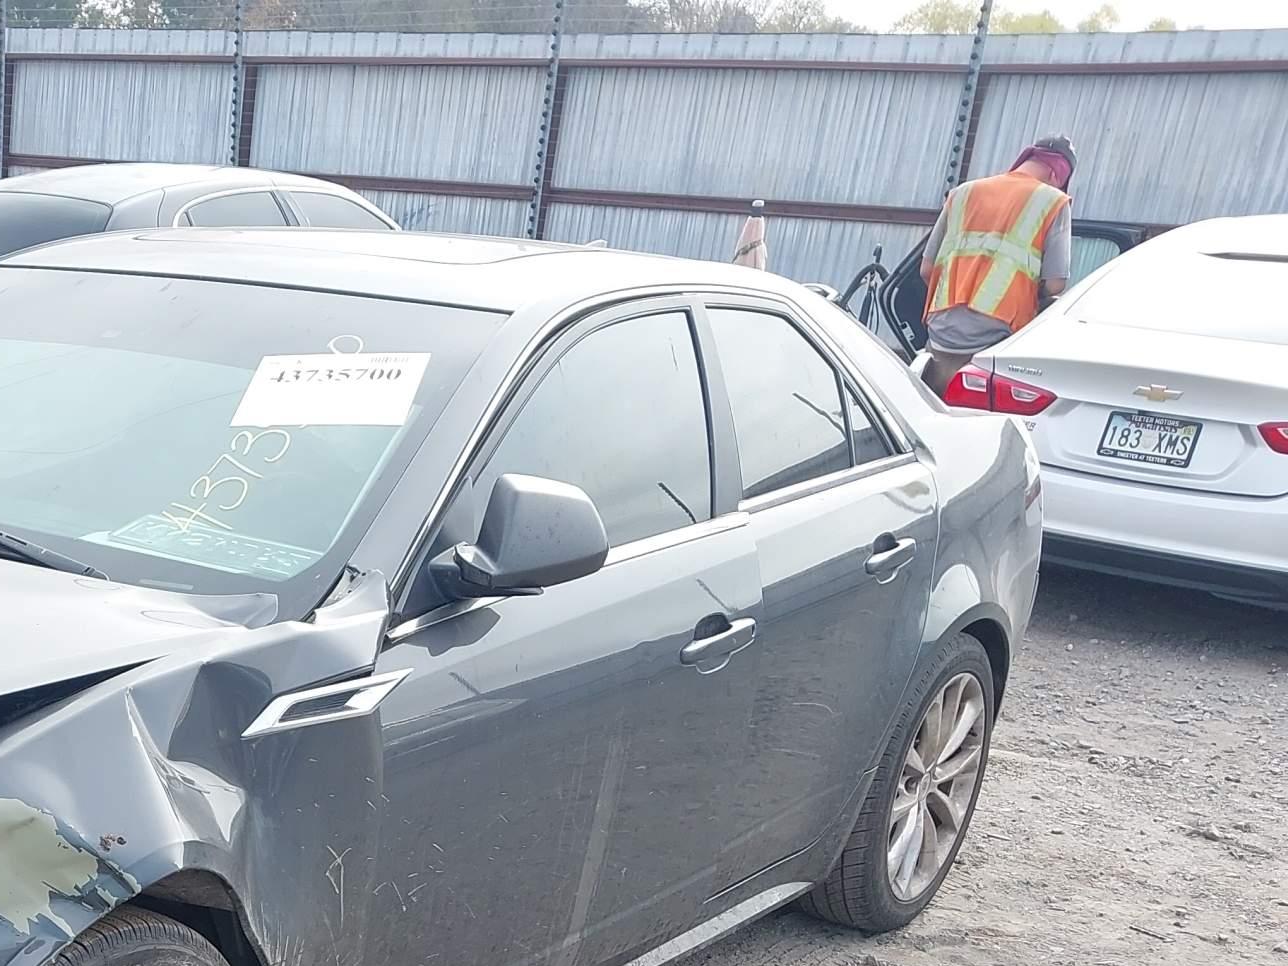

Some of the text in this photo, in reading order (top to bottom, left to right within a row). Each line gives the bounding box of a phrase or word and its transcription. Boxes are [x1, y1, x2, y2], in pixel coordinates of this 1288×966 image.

[269, 367, 403, 384] 43735700
[1154, 417, 1180, 427] MOTORS
[1108, 425, 1191, 456] 183 XMS
